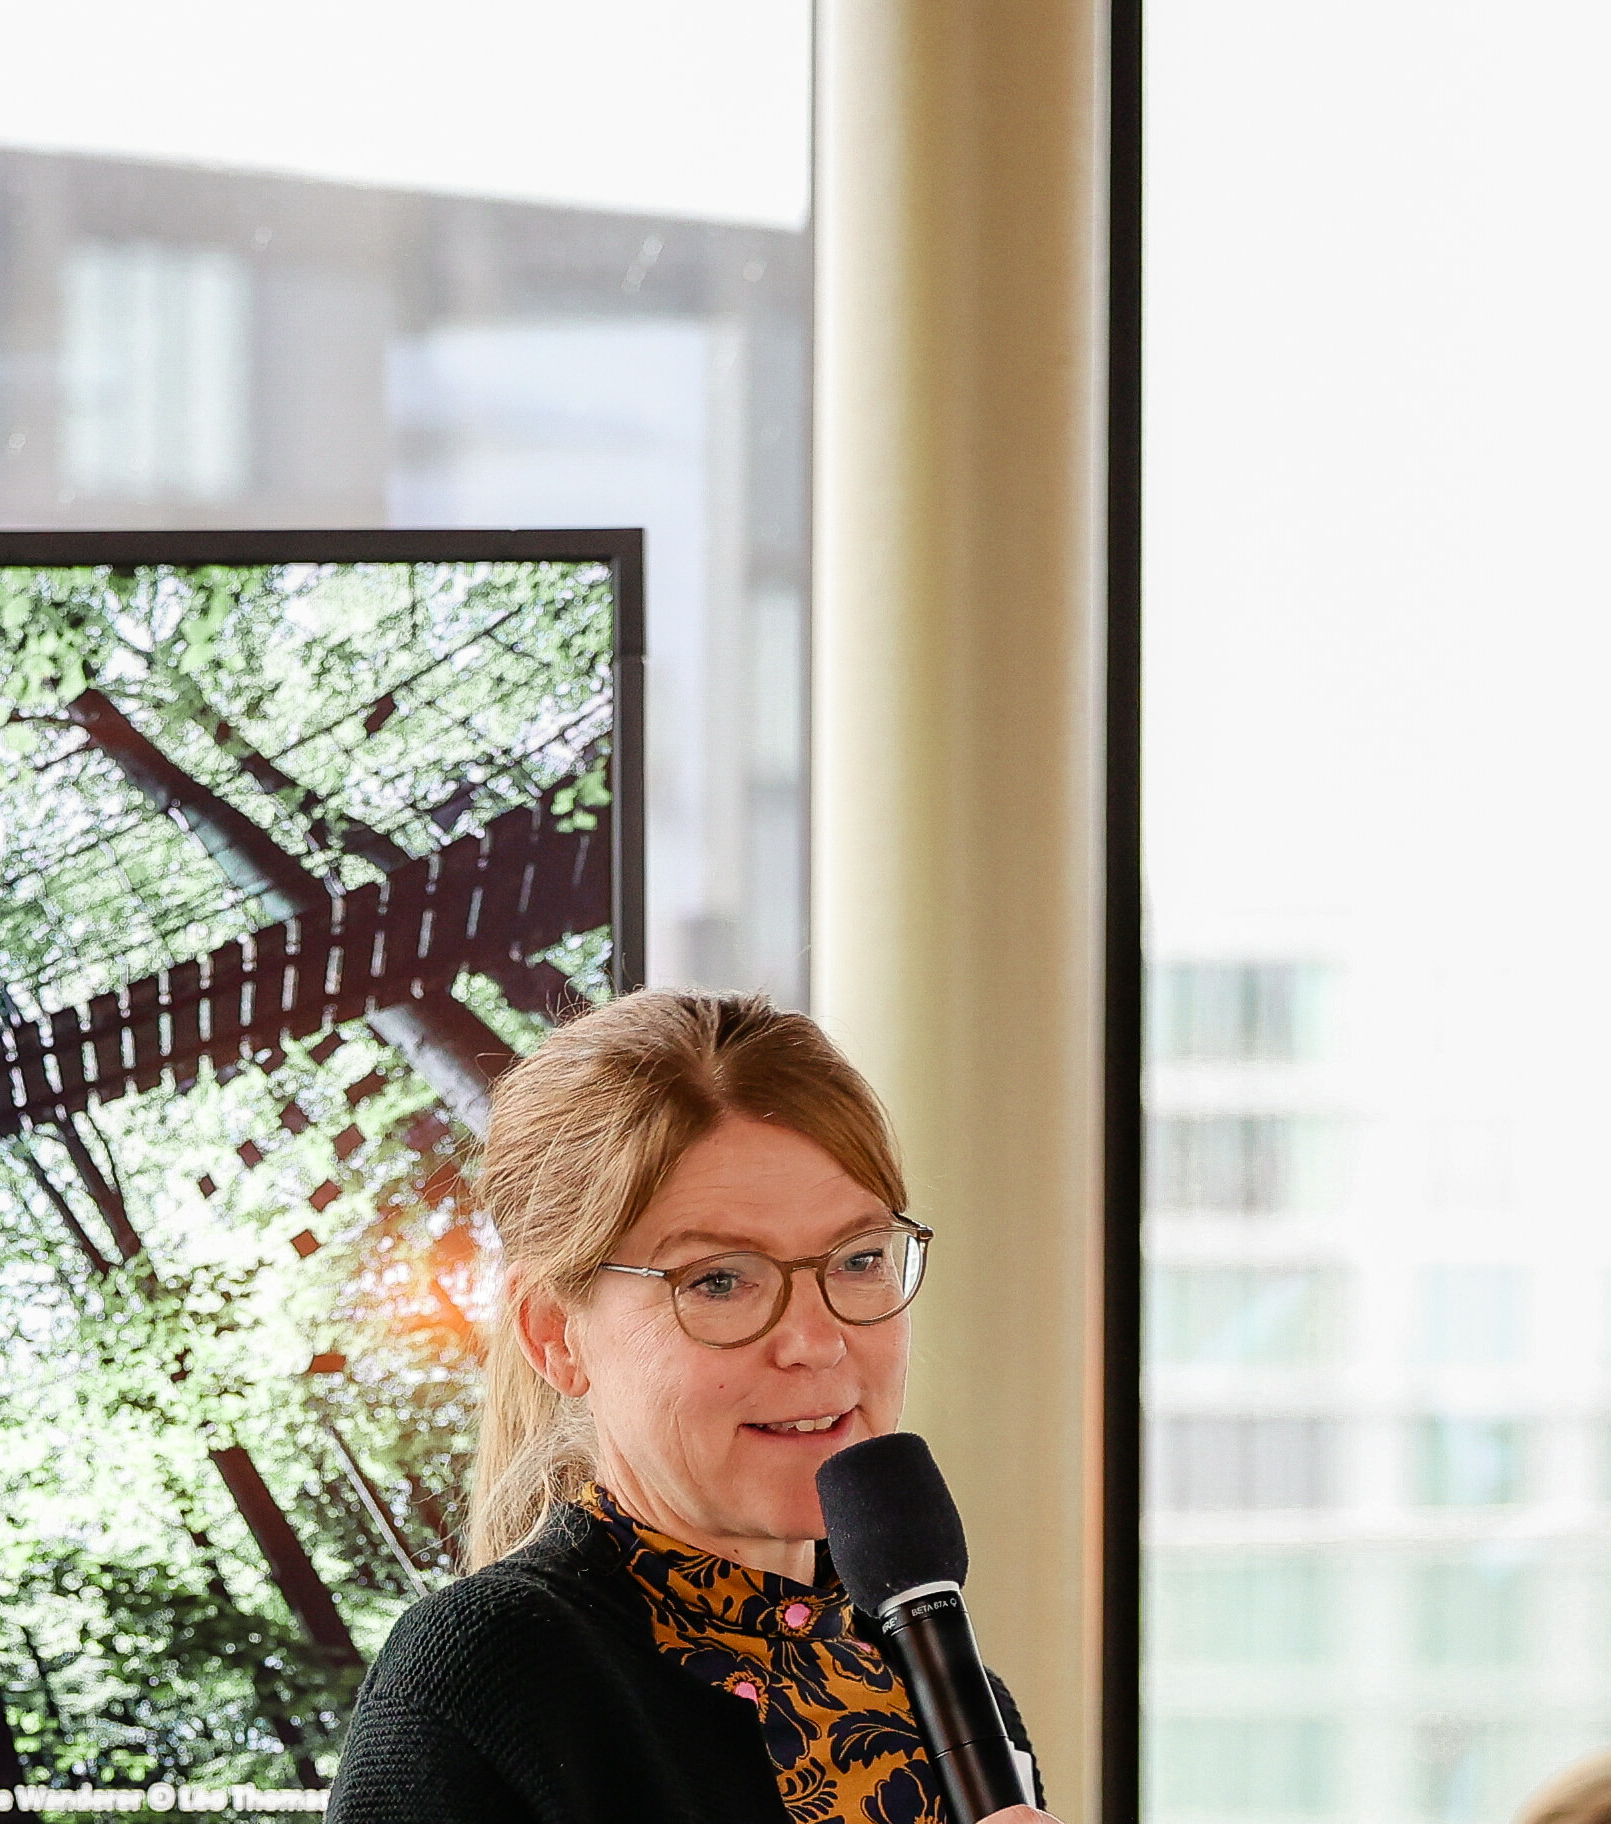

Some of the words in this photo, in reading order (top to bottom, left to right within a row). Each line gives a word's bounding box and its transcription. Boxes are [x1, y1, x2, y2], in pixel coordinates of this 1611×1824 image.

[911, 1605, 933, 1617] BETA
[14, 1783, 145, 1812] Wanderer
[177, 1784, 229, 1812] Leo
